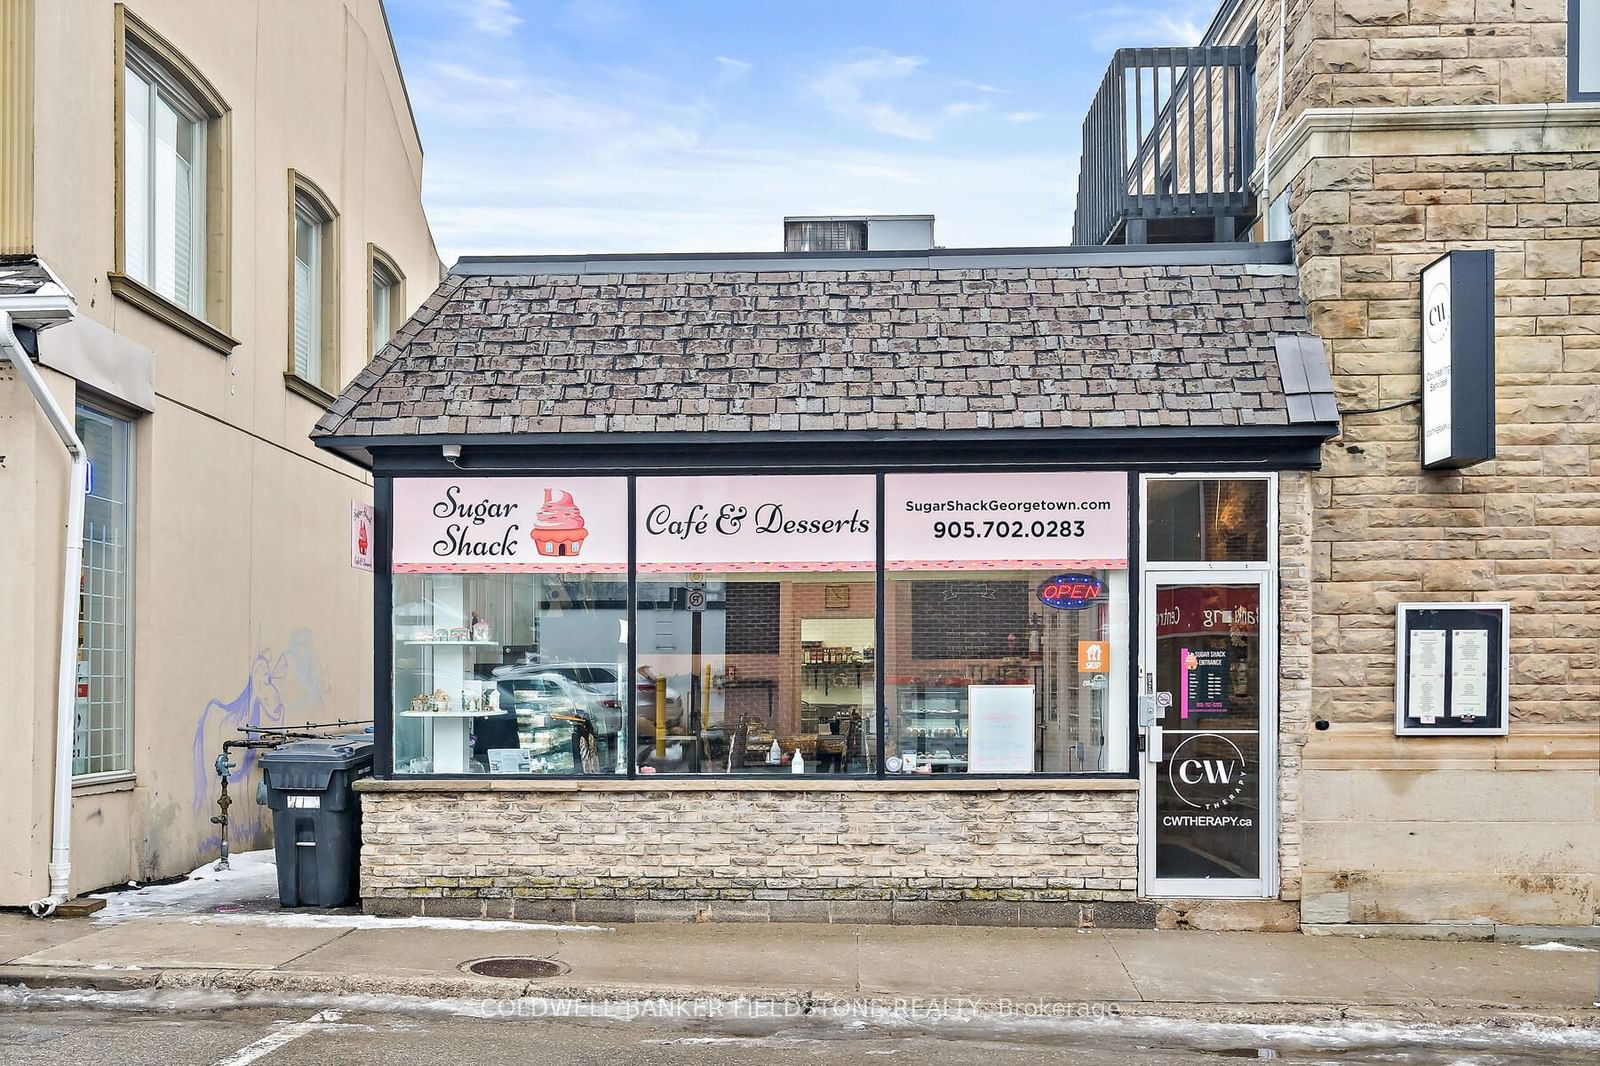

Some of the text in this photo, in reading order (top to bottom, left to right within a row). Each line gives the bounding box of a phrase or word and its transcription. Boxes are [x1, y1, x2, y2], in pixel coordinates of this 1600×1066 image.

[432, 485, 518, 525] Sugar
[905, 500, 1111, 513] SugarShackGeorgetown.com
[645, 503, 870, 540] Café & Desserts
[933, 520, 1085, 538] 905.702.0283
[432, 523, 519, 557] Shack
[1043, 582, 1102, 602] OPEN
[1195, 650, 1226, 658] SUGAR SHACK
[1179, 759, 1235, 784] CW
[1205, 771, 1247, 810] THERAPY
[1163, 815, 1252, 827] CWTHERAPY.ca
